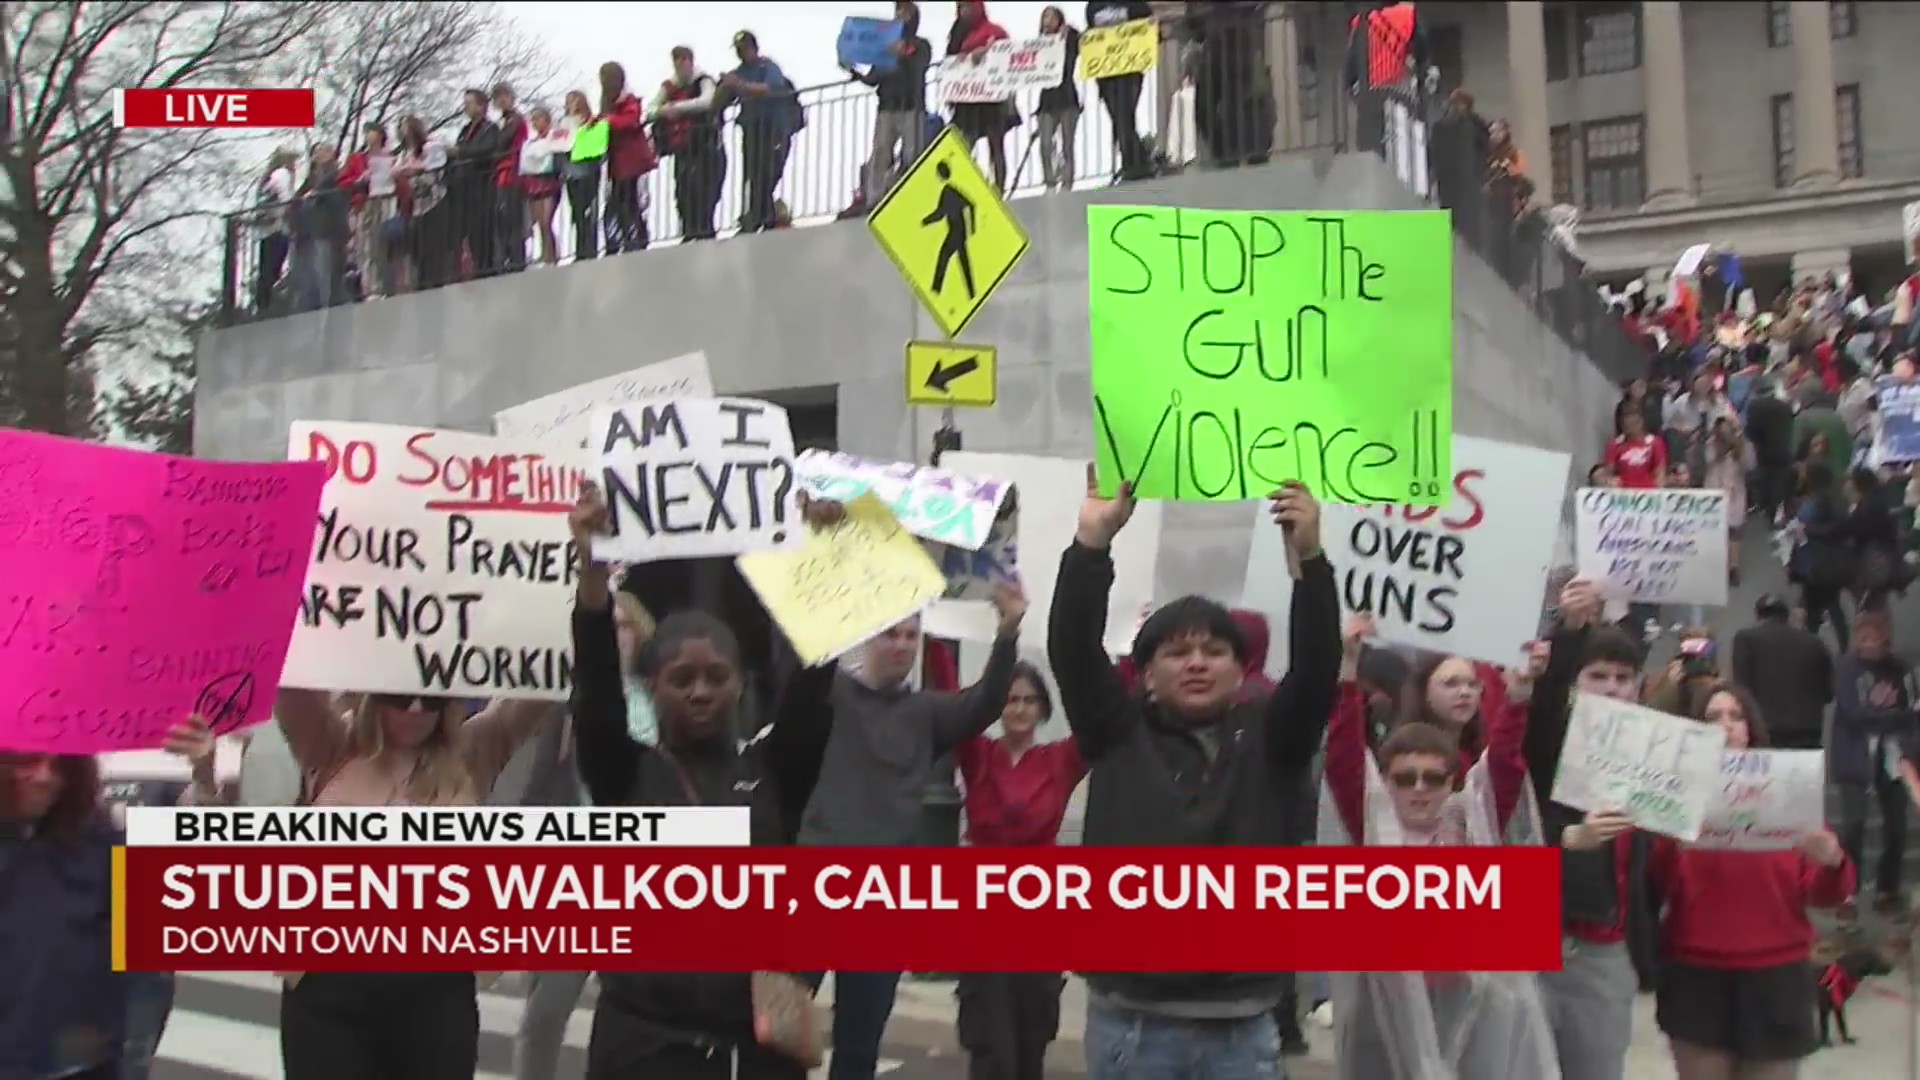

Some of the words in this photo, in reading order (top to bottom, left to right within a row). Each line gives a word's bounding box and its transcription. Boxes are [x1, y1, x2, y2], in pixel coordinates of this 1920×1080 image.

[602, 400, 689, 454] AM
[720, 402, 771, 449] I
[397, 432, 585, 500] SOMETHIN
[602, 455, 794, 544] NEXT?
[317, 506, 426, 573] YOUR
[447, 514, 579, 586] PRAYER
[1351, 517, 1466, 580] OVER
[376, 586, 483, 641] NOT
[1344, 567, 1459, 634] UNS
[414, 643, 577, 690] WORKIN
